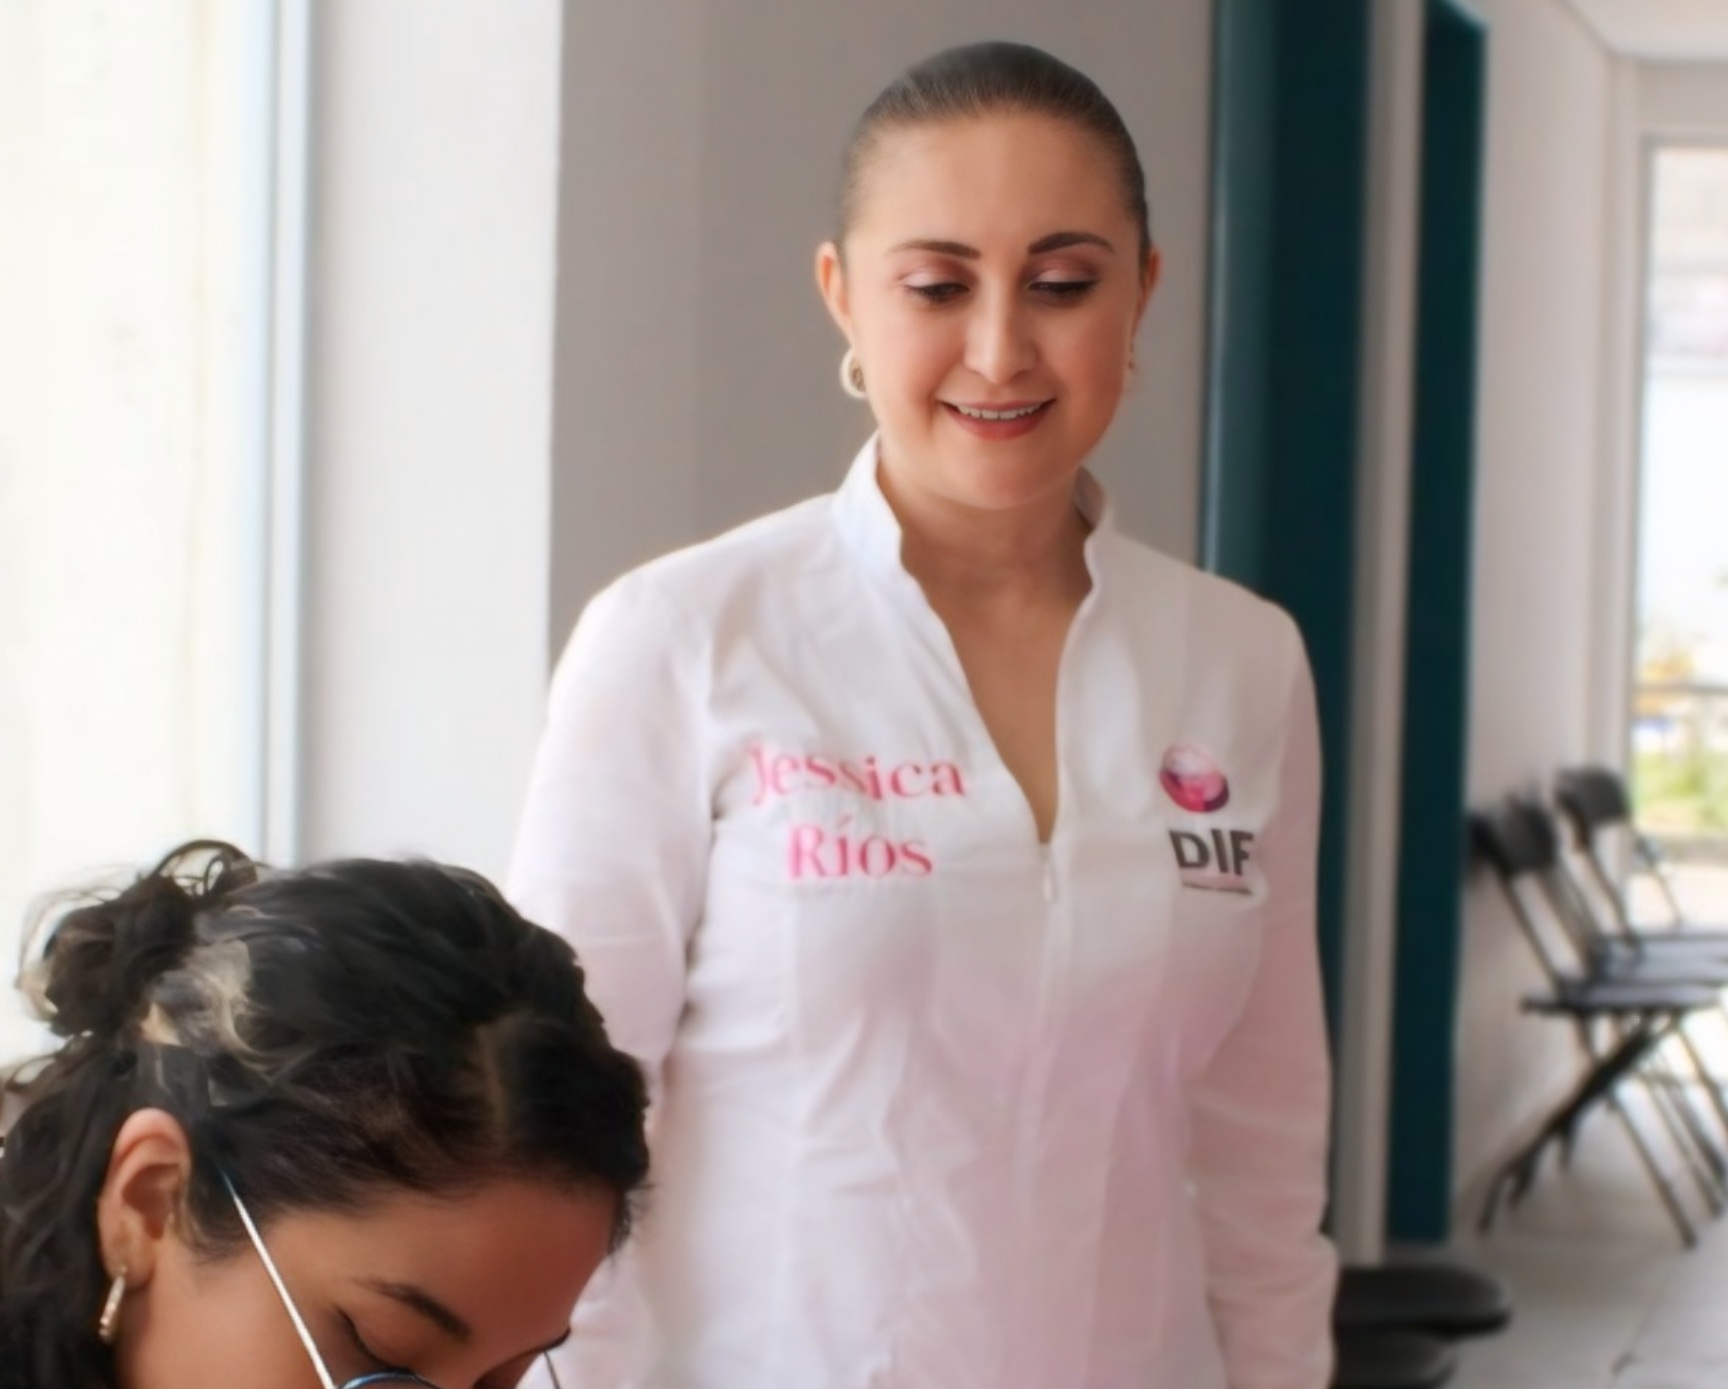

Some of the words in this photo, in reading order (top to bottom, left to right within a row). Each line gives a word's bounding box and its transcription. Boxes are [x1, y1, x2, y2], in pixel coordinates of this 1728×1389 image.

[749, 742, 966, 806] Jessica
[788, 814, 934, 878] Ríos
[1168, 828, 1255, 877] DIF
